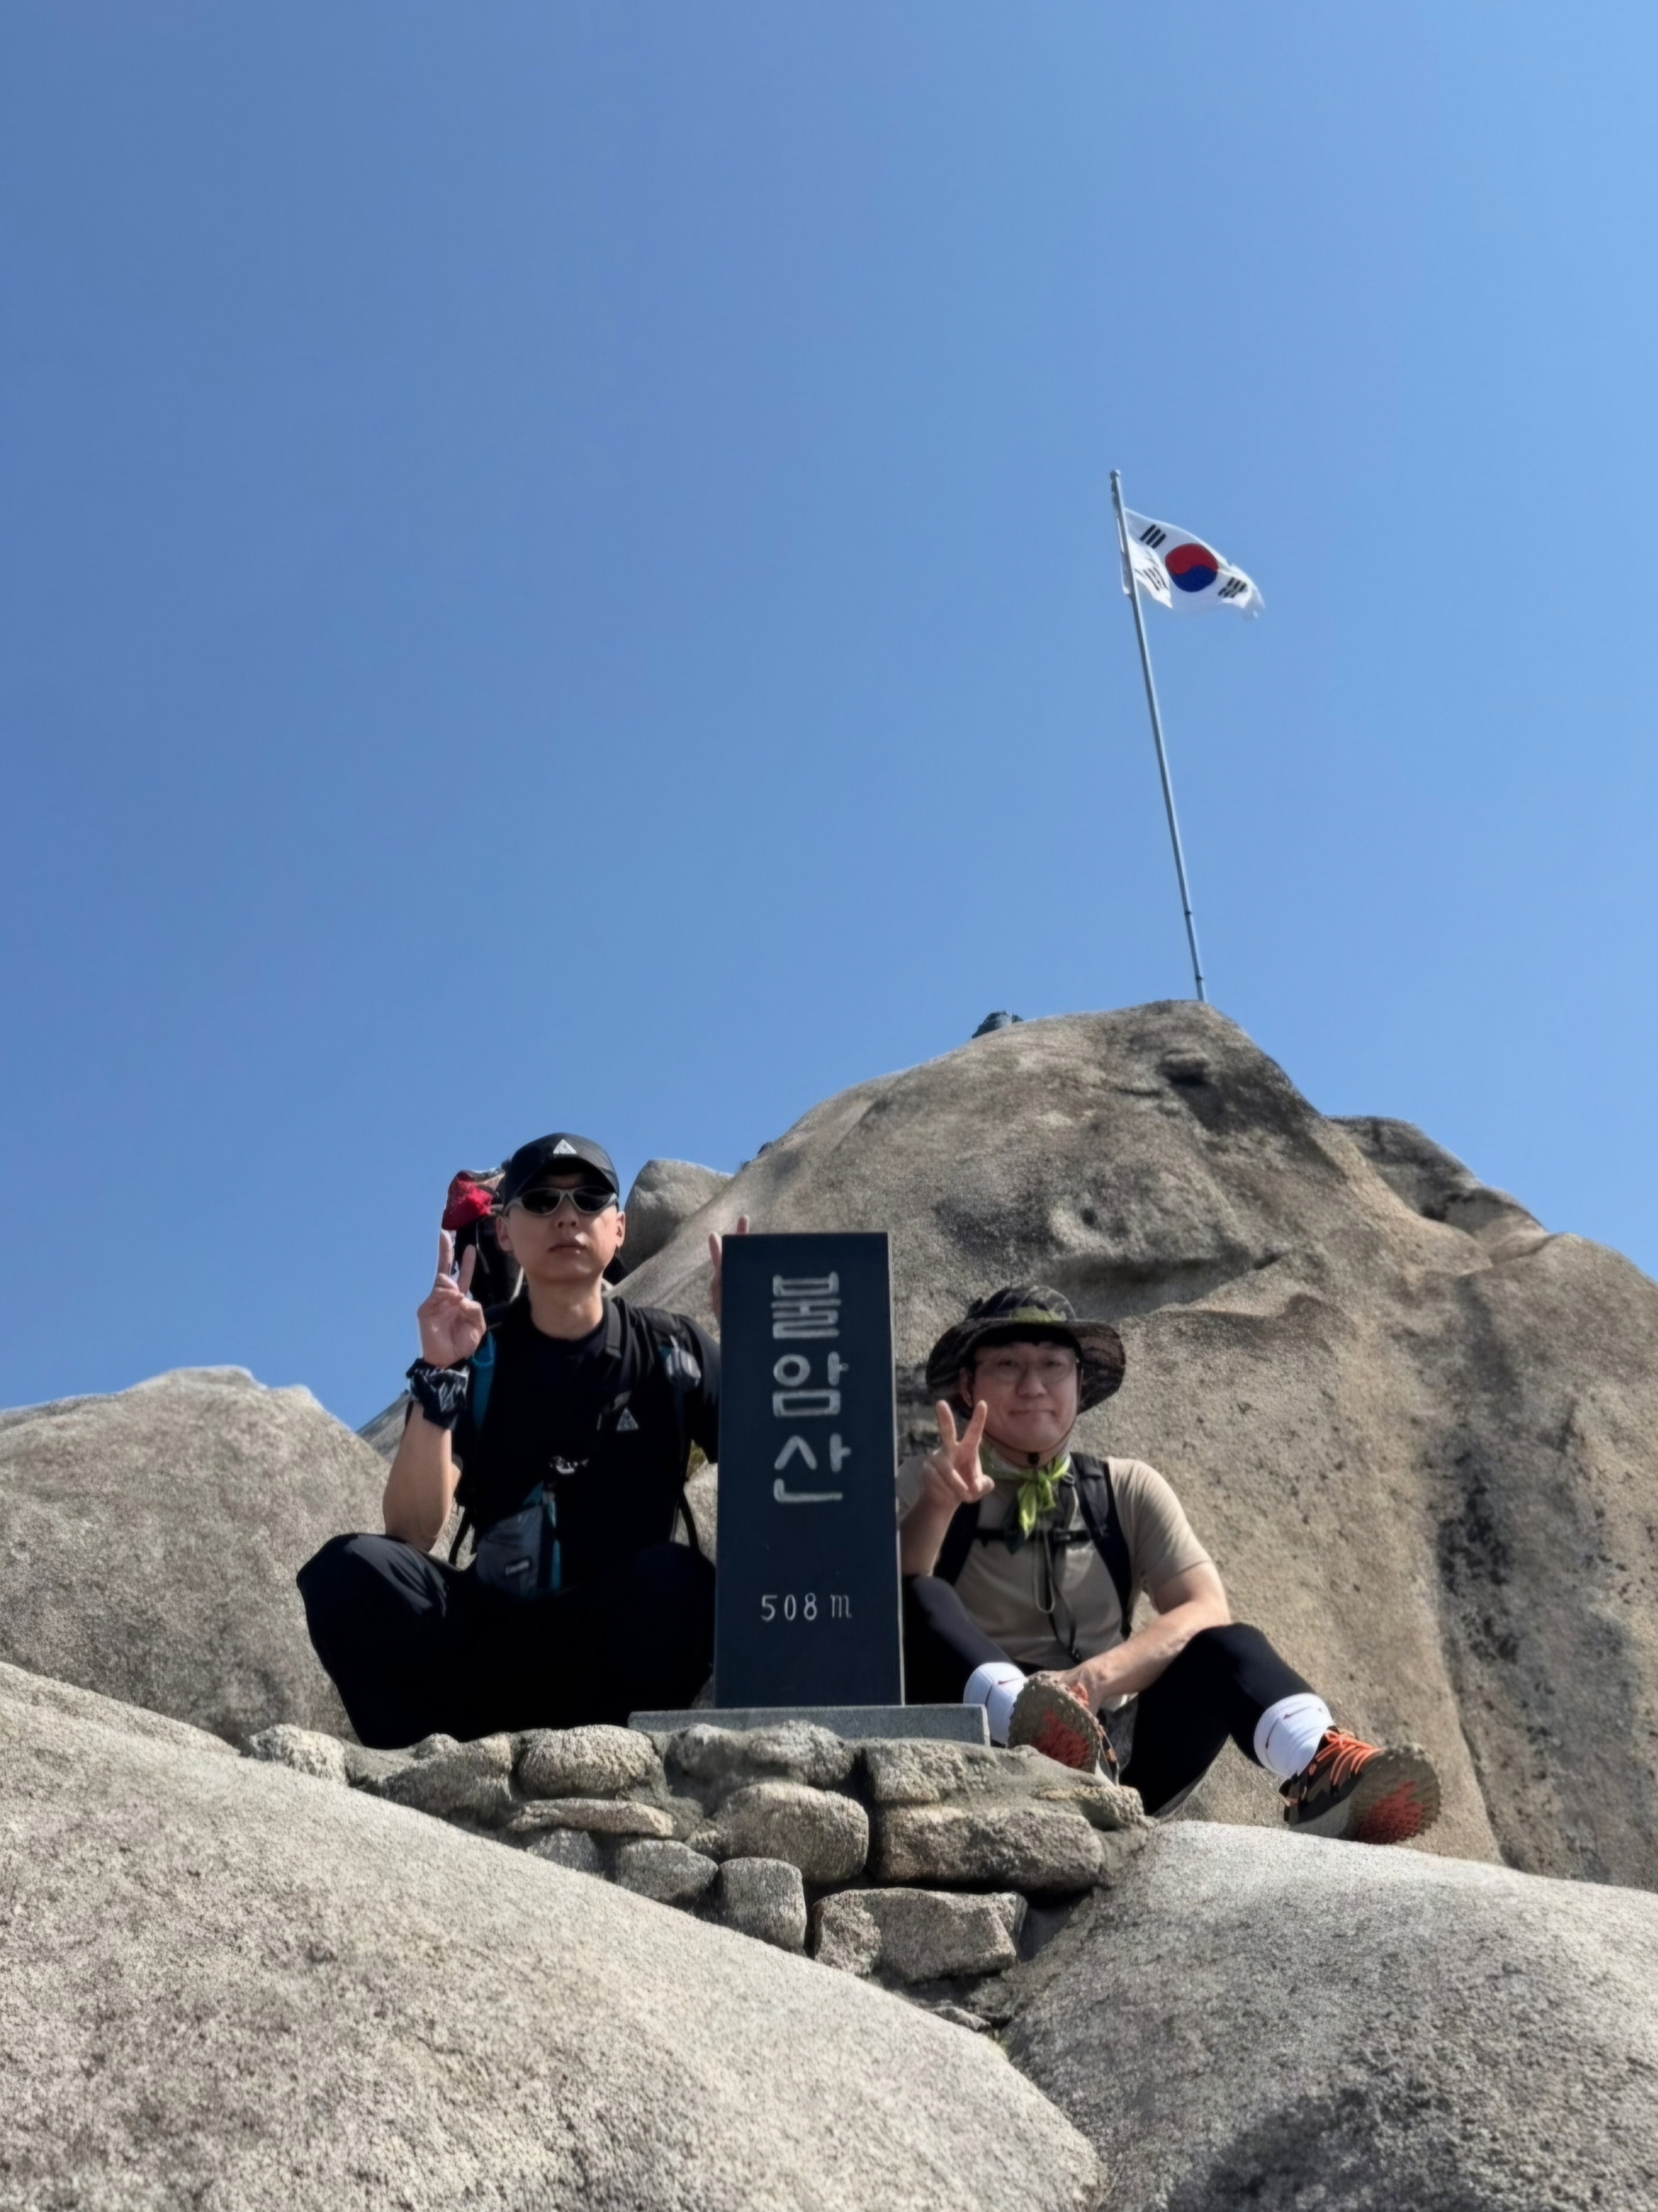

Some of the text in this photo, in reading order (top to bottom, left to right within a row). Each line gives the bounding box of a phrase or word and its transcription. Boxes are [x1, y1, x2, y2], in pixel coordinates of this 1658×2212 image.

[771, 1271, 851, 1503] 불암산
[761, 1592, 852, 1622] 508 m
